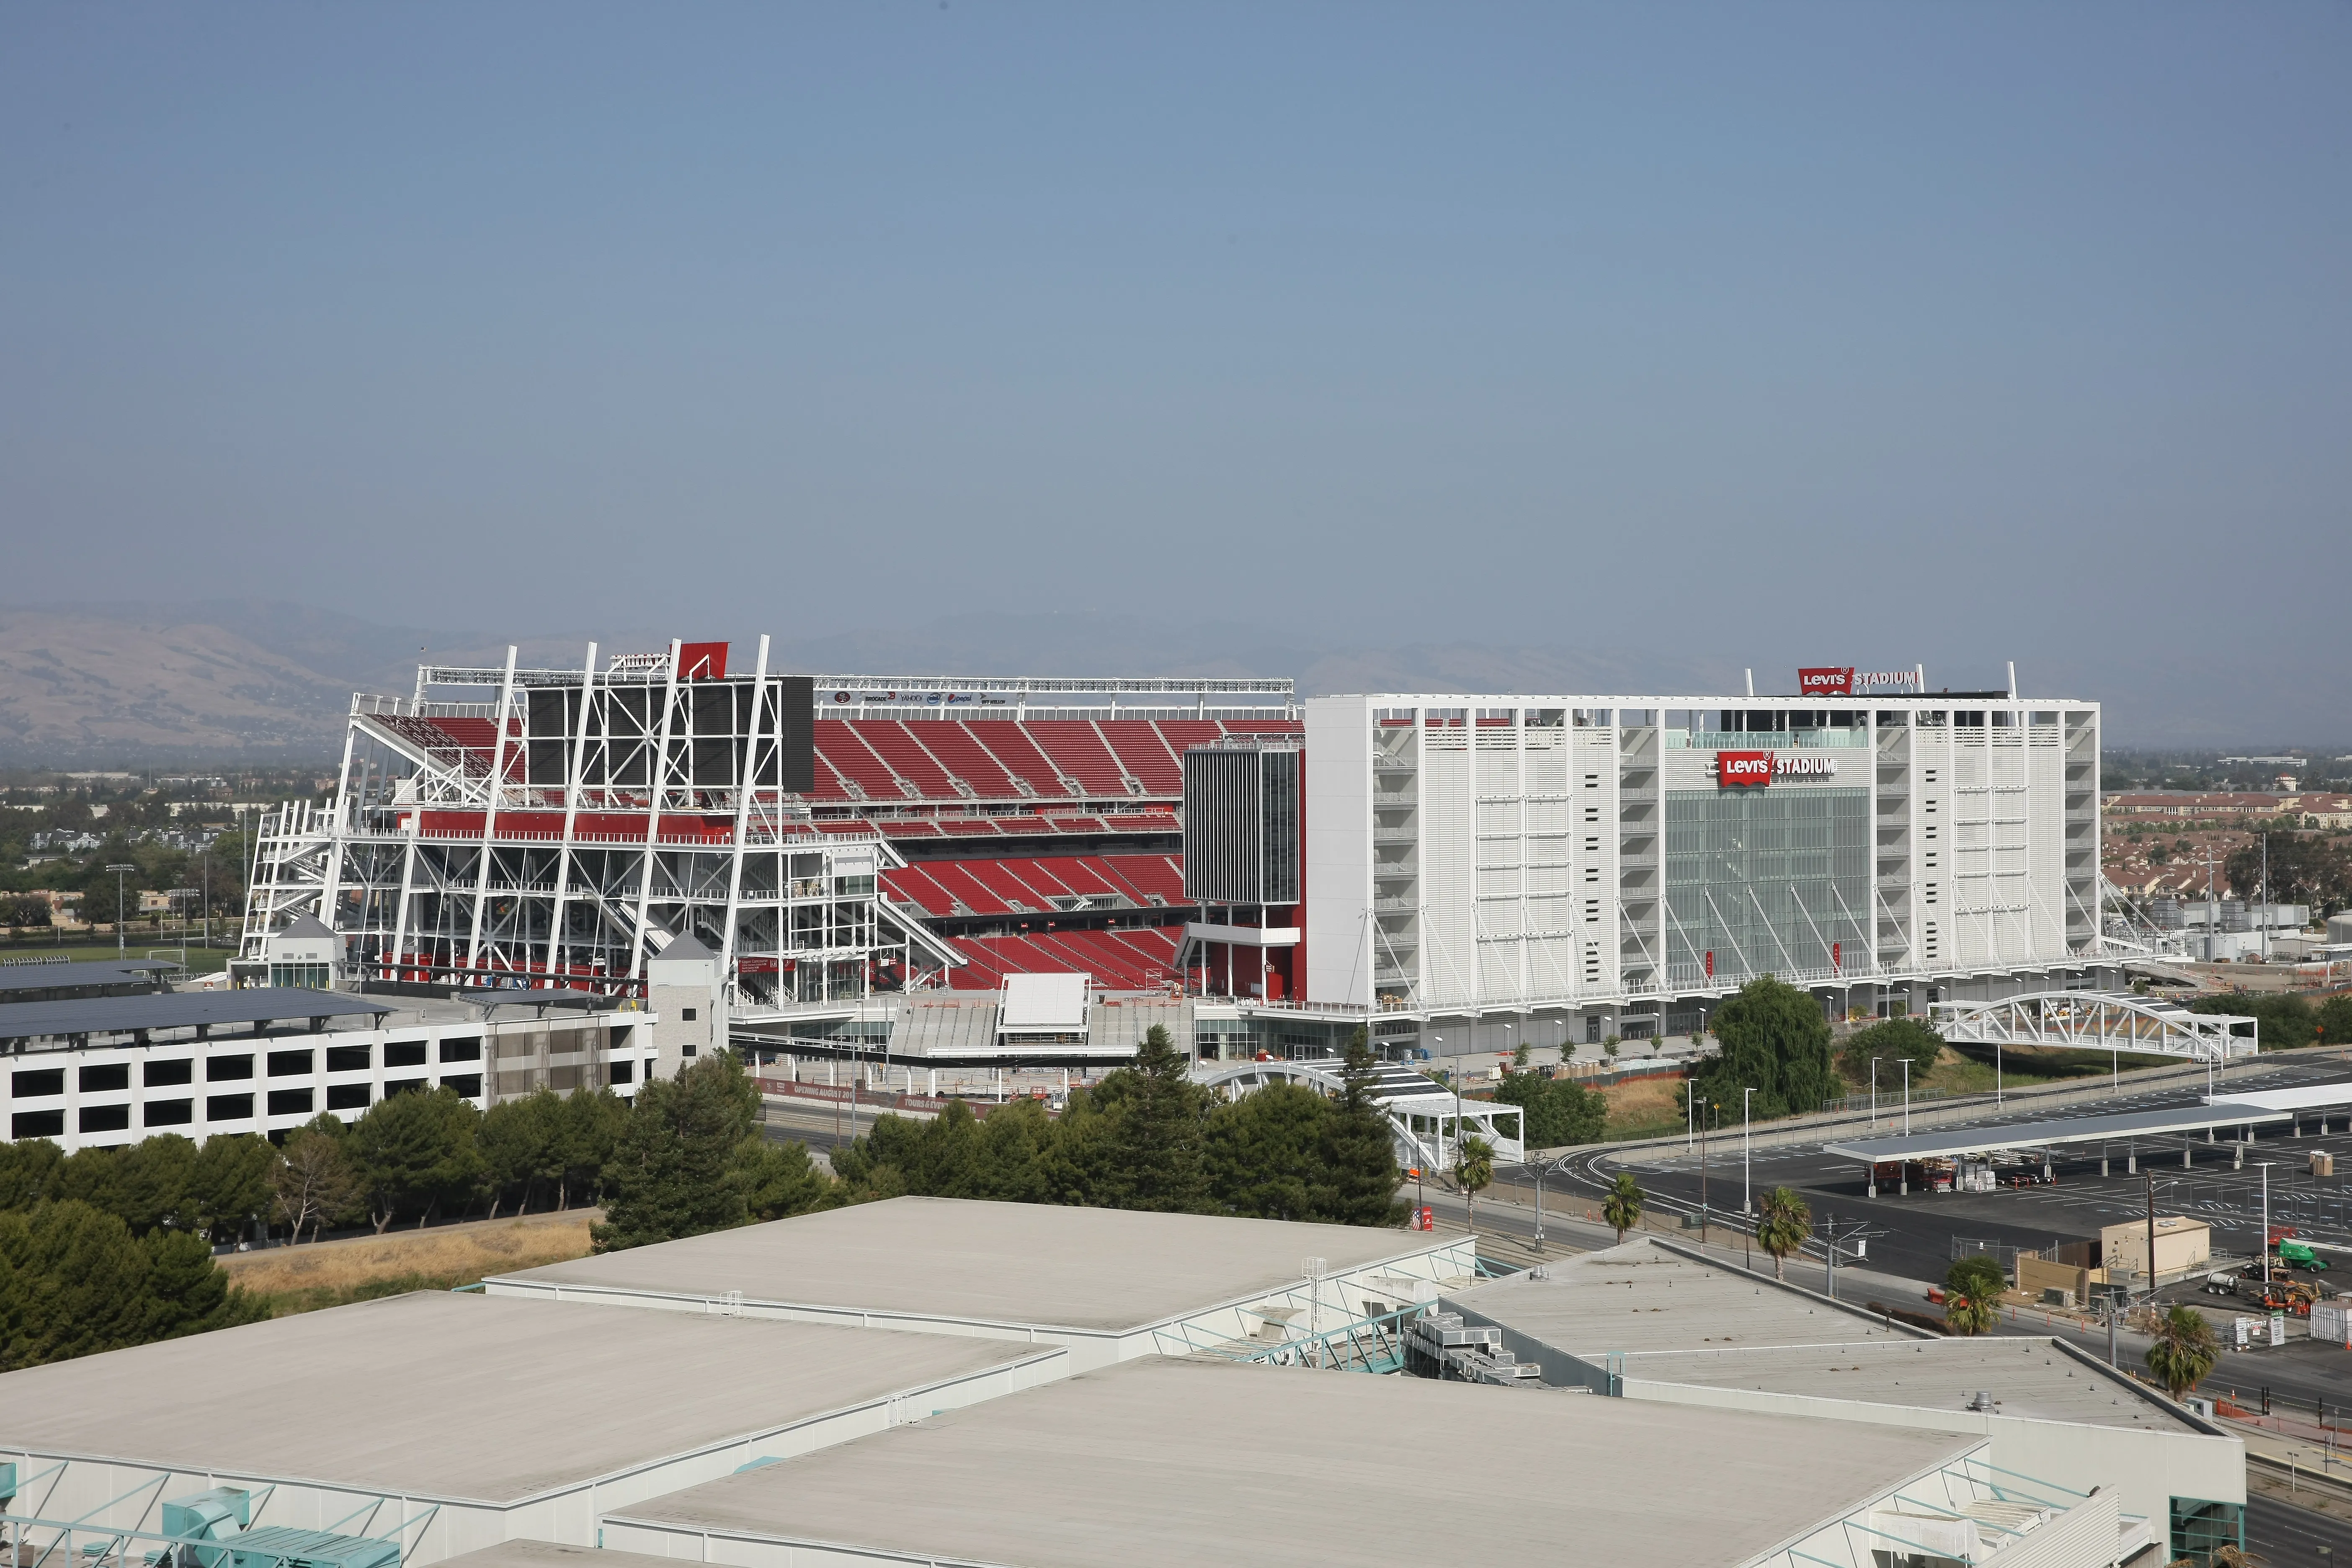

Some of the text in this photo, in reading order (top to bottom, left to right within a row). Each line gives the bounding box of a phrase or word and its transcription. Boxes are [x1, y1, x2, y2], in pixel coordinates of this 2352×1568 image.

[1854, 672, 1916, 685] STADIUM
[1777, 758, 1834, 774] STADIUM
[794, 1085, 819, 1096] OPENING
[819, 1089, 841, 1099] AUGUST
[905, 1098, 924, 1108] TOURS
